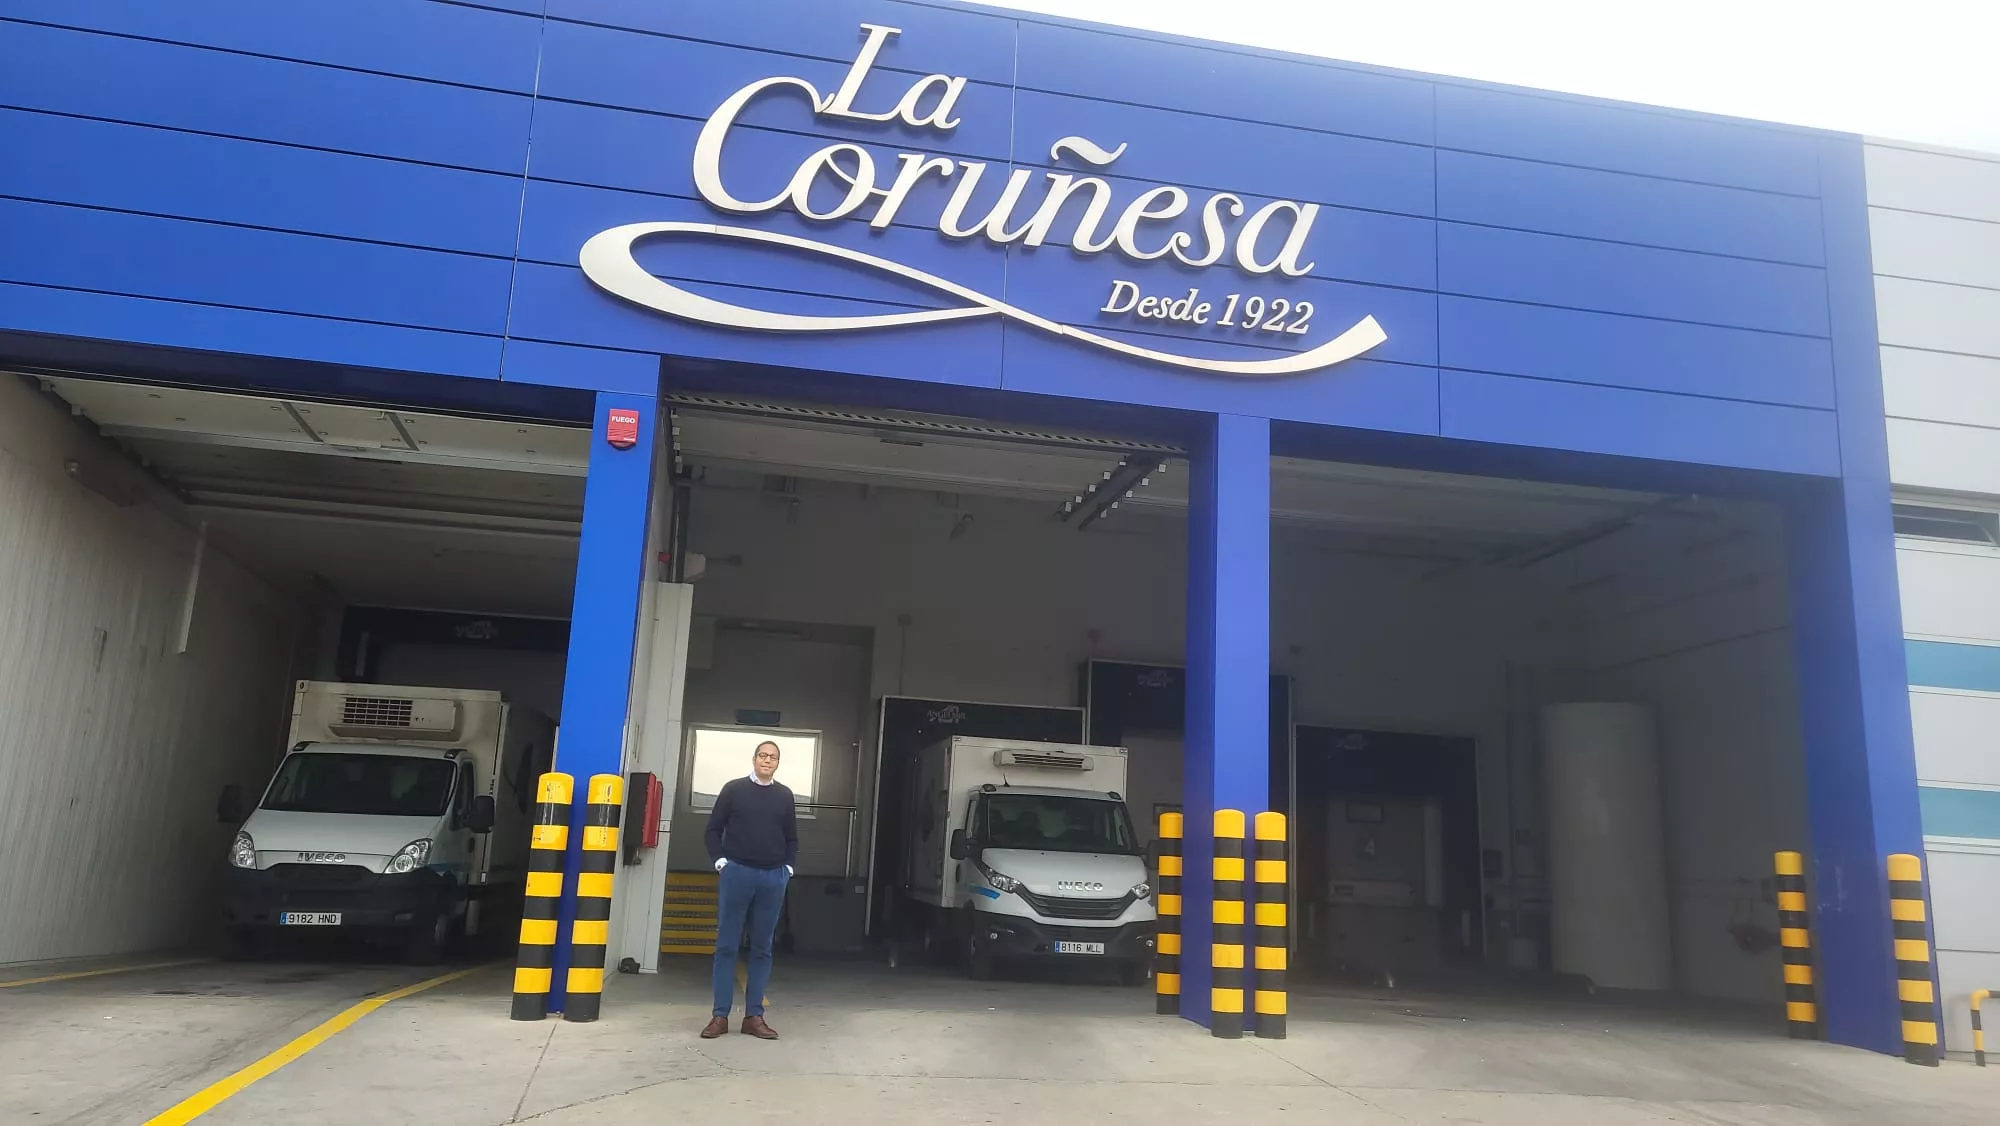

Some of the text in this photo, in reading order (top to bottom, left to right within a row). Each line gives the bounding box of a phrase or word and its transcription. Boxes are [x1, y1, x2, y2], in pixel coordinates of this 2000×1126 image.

[823, 23, 963, 129] La
[692, 76, 1319, 277] Coruñesa
[1100, 279, 1315, 335] Desde 1922
[611, 415, 636, 424] FUEGO
[296, 852, 346, 863] IVECO
[1057, 881, 1104, 892] IVECO
[288, 913, 337, 924] 9182 HND
[1061, 942, 1102, 953] 8116 MLL
